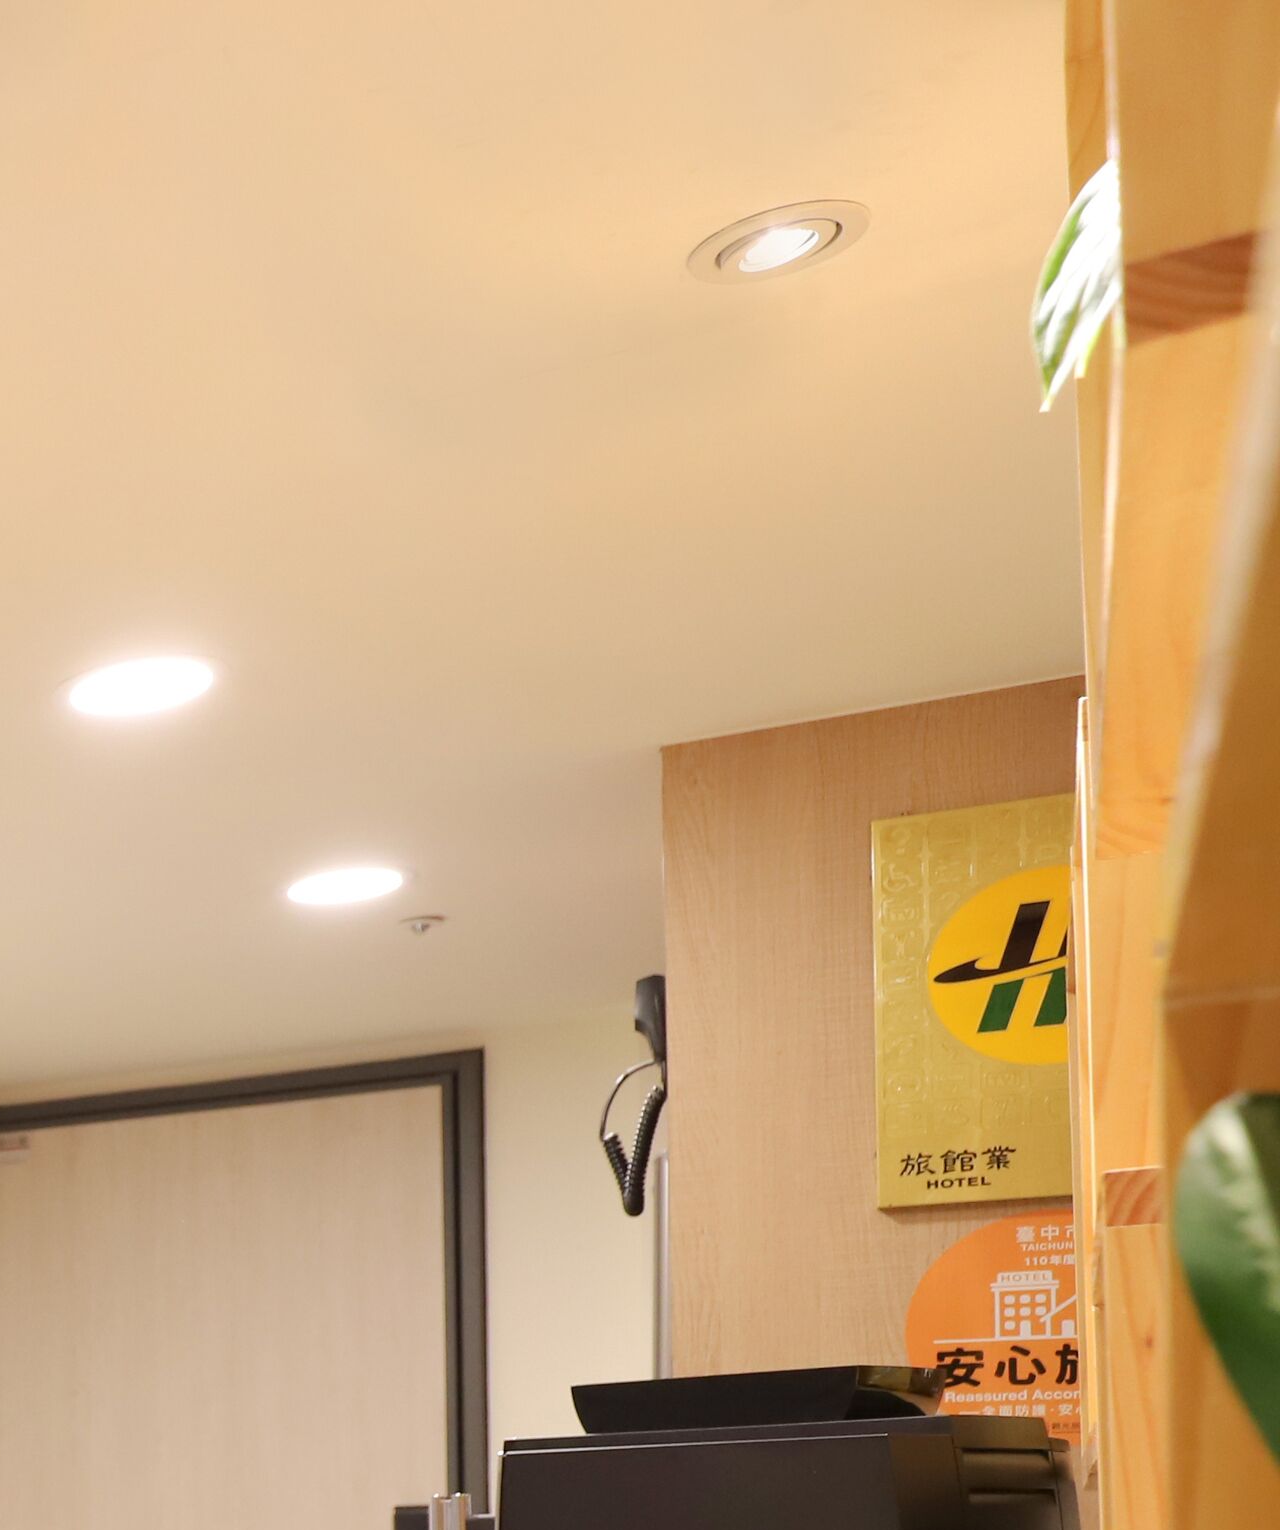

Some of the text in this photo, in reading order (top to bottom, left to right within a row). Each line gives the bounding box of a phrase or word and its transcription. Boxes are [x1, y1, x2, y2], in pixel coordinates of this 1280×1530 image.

[899, 1145, 1017, 1176] 旅館業
[926, 1176, 991, 1190] HOTEL
[1019, 1240, 1075, 1252] TAICHUN
[1000, 1272, 1048, 1283] HOTEL
[944, 1388, 1028, 1403] Reassured
